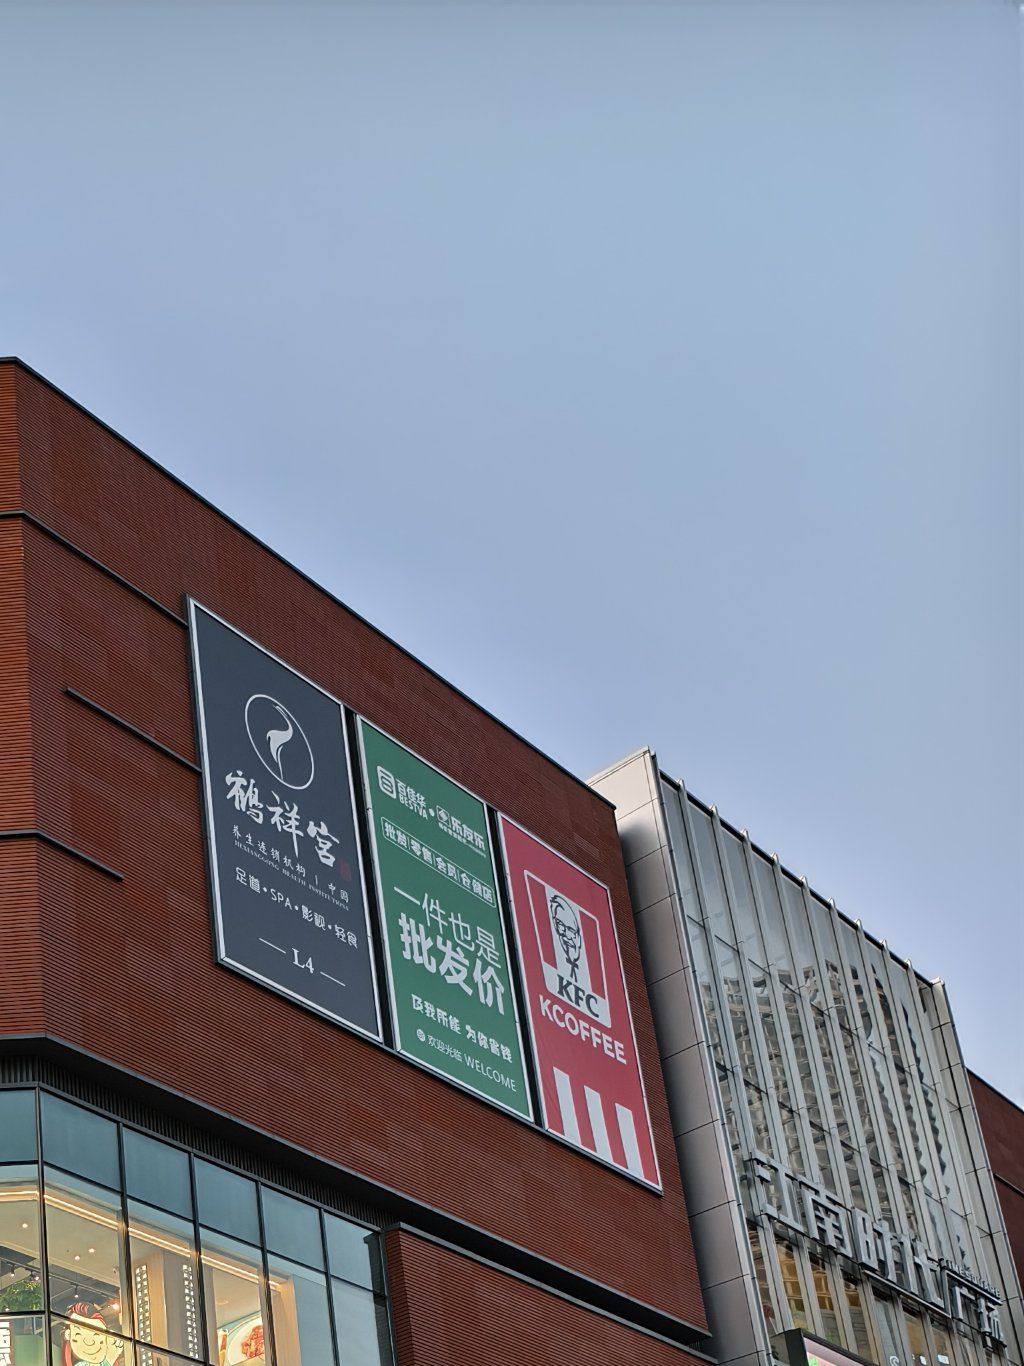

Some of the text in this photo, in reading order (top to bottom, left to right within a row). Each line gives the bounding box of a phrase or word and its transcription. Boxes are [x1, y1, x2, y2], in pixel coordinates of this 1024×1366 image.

[394, 887, 501, 968] 一件也是
[292, 948, 314, 974] L4
[398, 912, 505, 1015] 批发价
[557, 974, 600, 1018] KFC
[539, 994, 627, 1065] KCOFFEE
[464, 1053, 517, 1092] WELCOME
